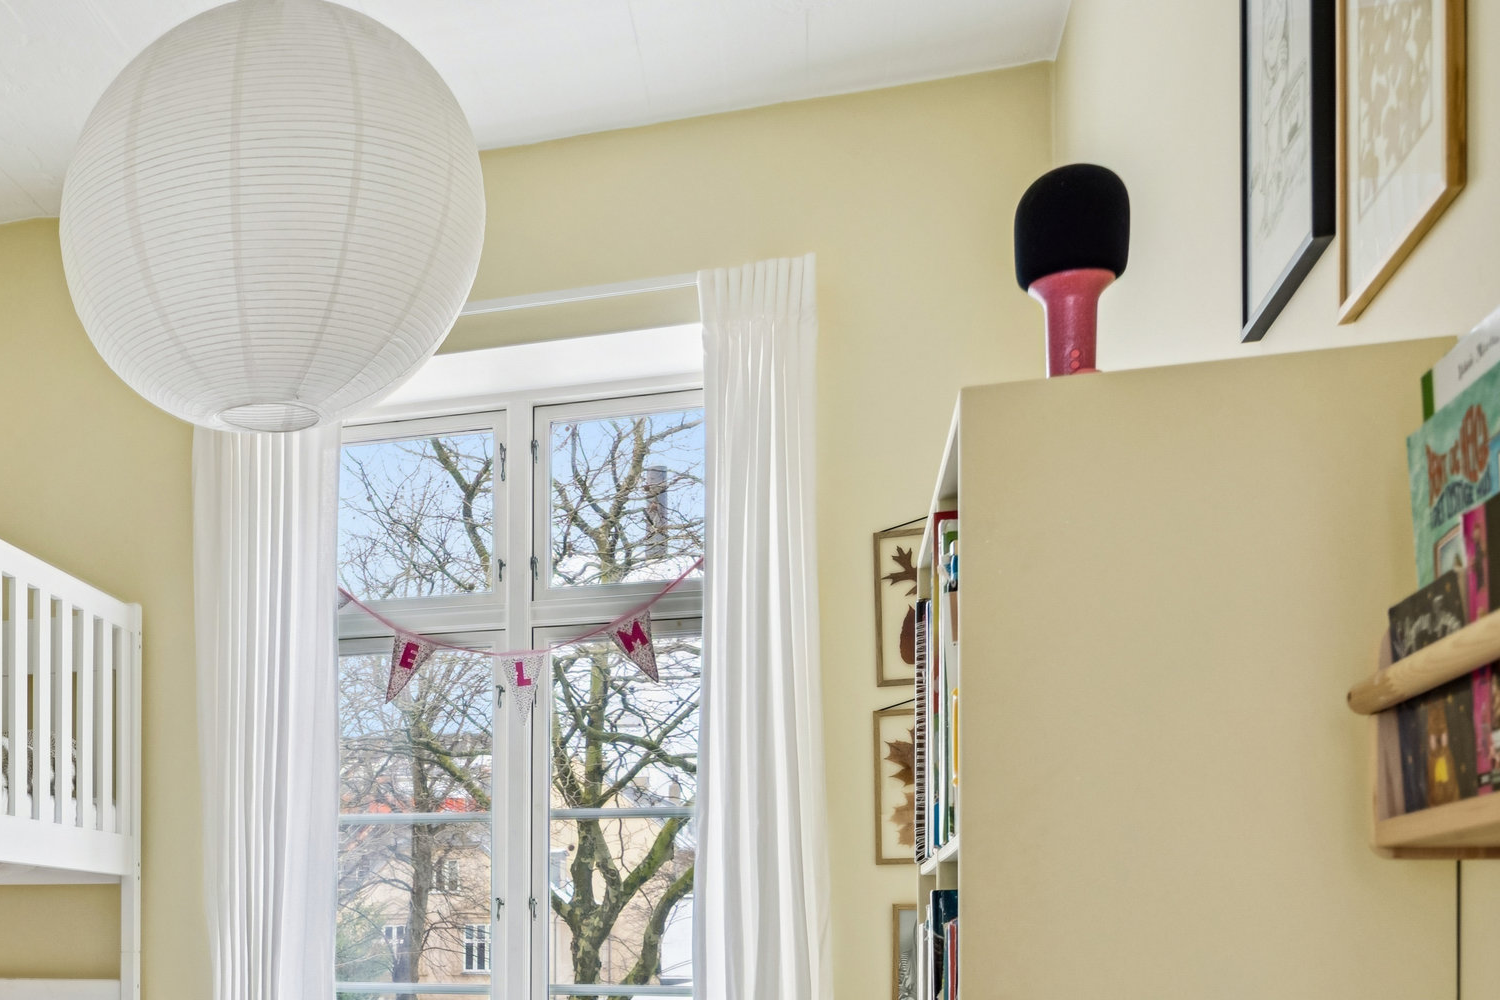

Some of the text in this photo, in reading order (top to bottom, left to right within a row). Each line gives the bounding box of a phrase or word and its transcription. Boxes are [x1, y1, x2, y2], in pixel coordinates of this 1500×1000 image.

[399, 620, 649, 687] E L M
